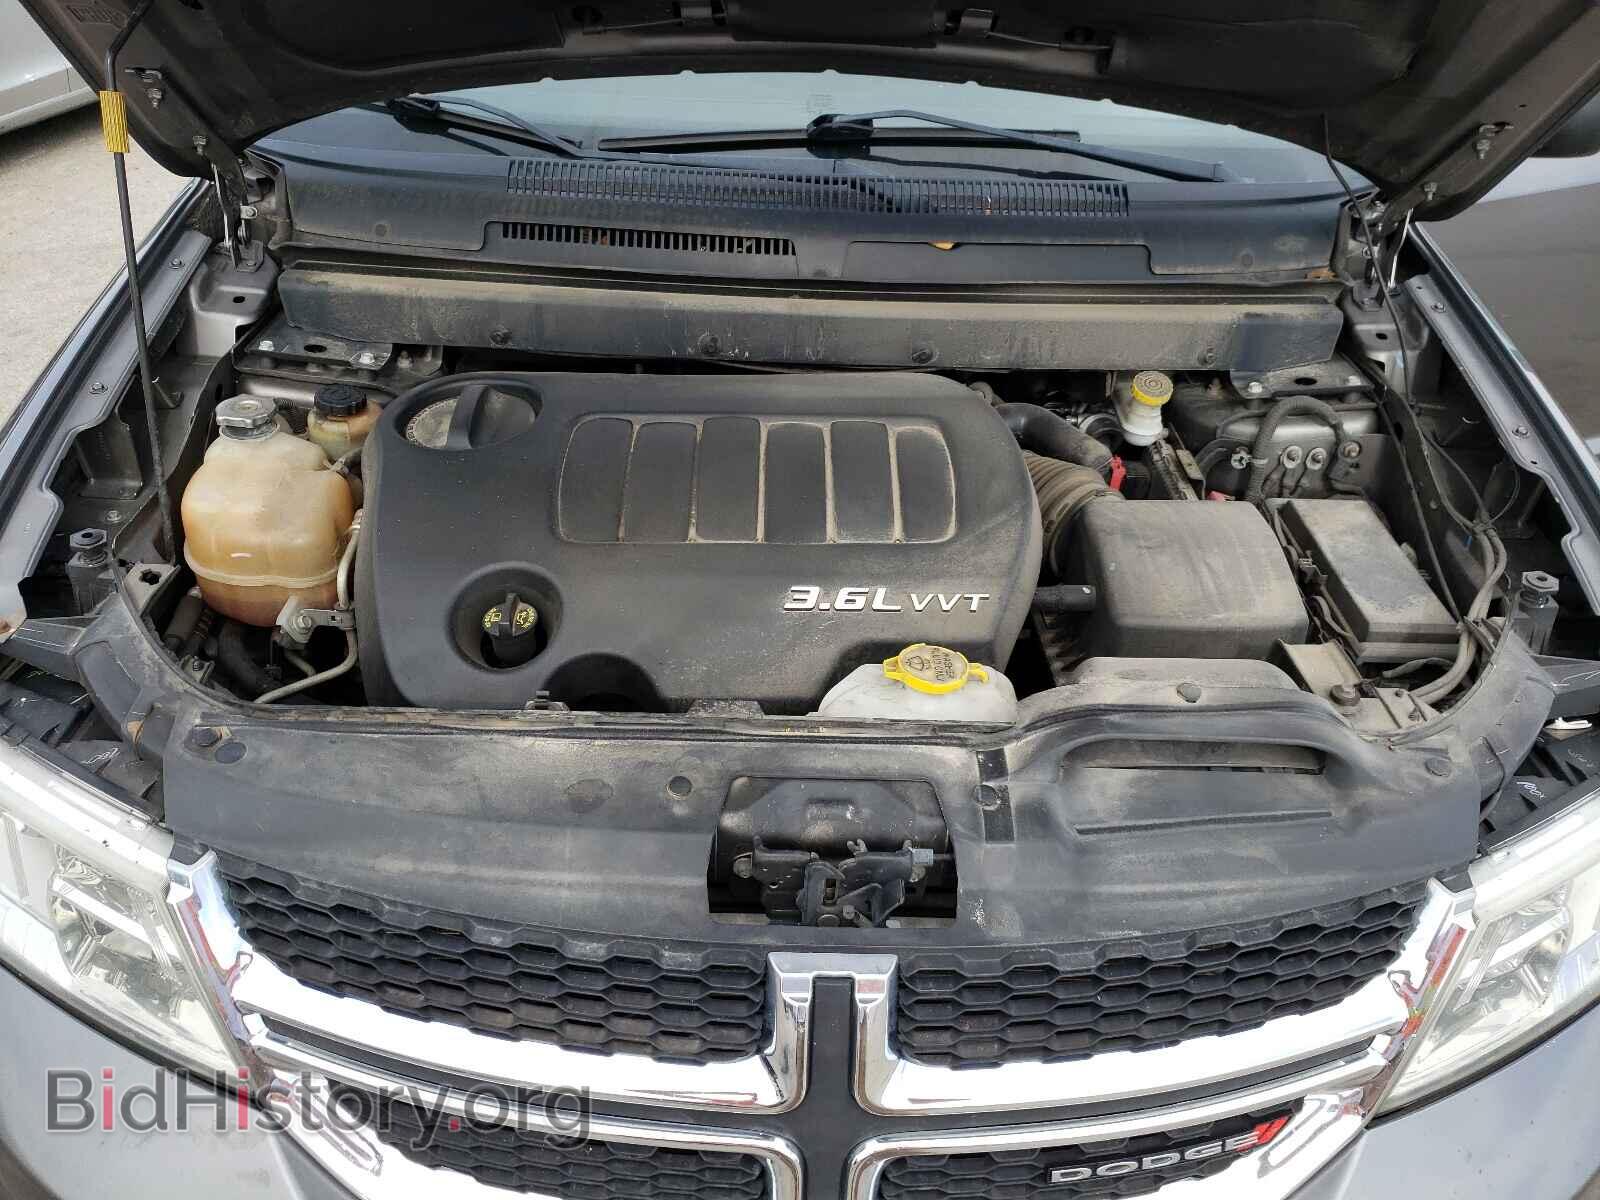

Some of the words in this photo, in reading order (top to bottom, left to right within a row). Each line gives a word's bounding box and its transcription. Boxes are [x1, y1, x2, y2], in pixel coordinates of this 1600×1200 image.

[783, 586, 903, 612] 3.6L
[910, 593, 990, 612] VVT
[1050, 1131, 1260, 1183] DODGE
